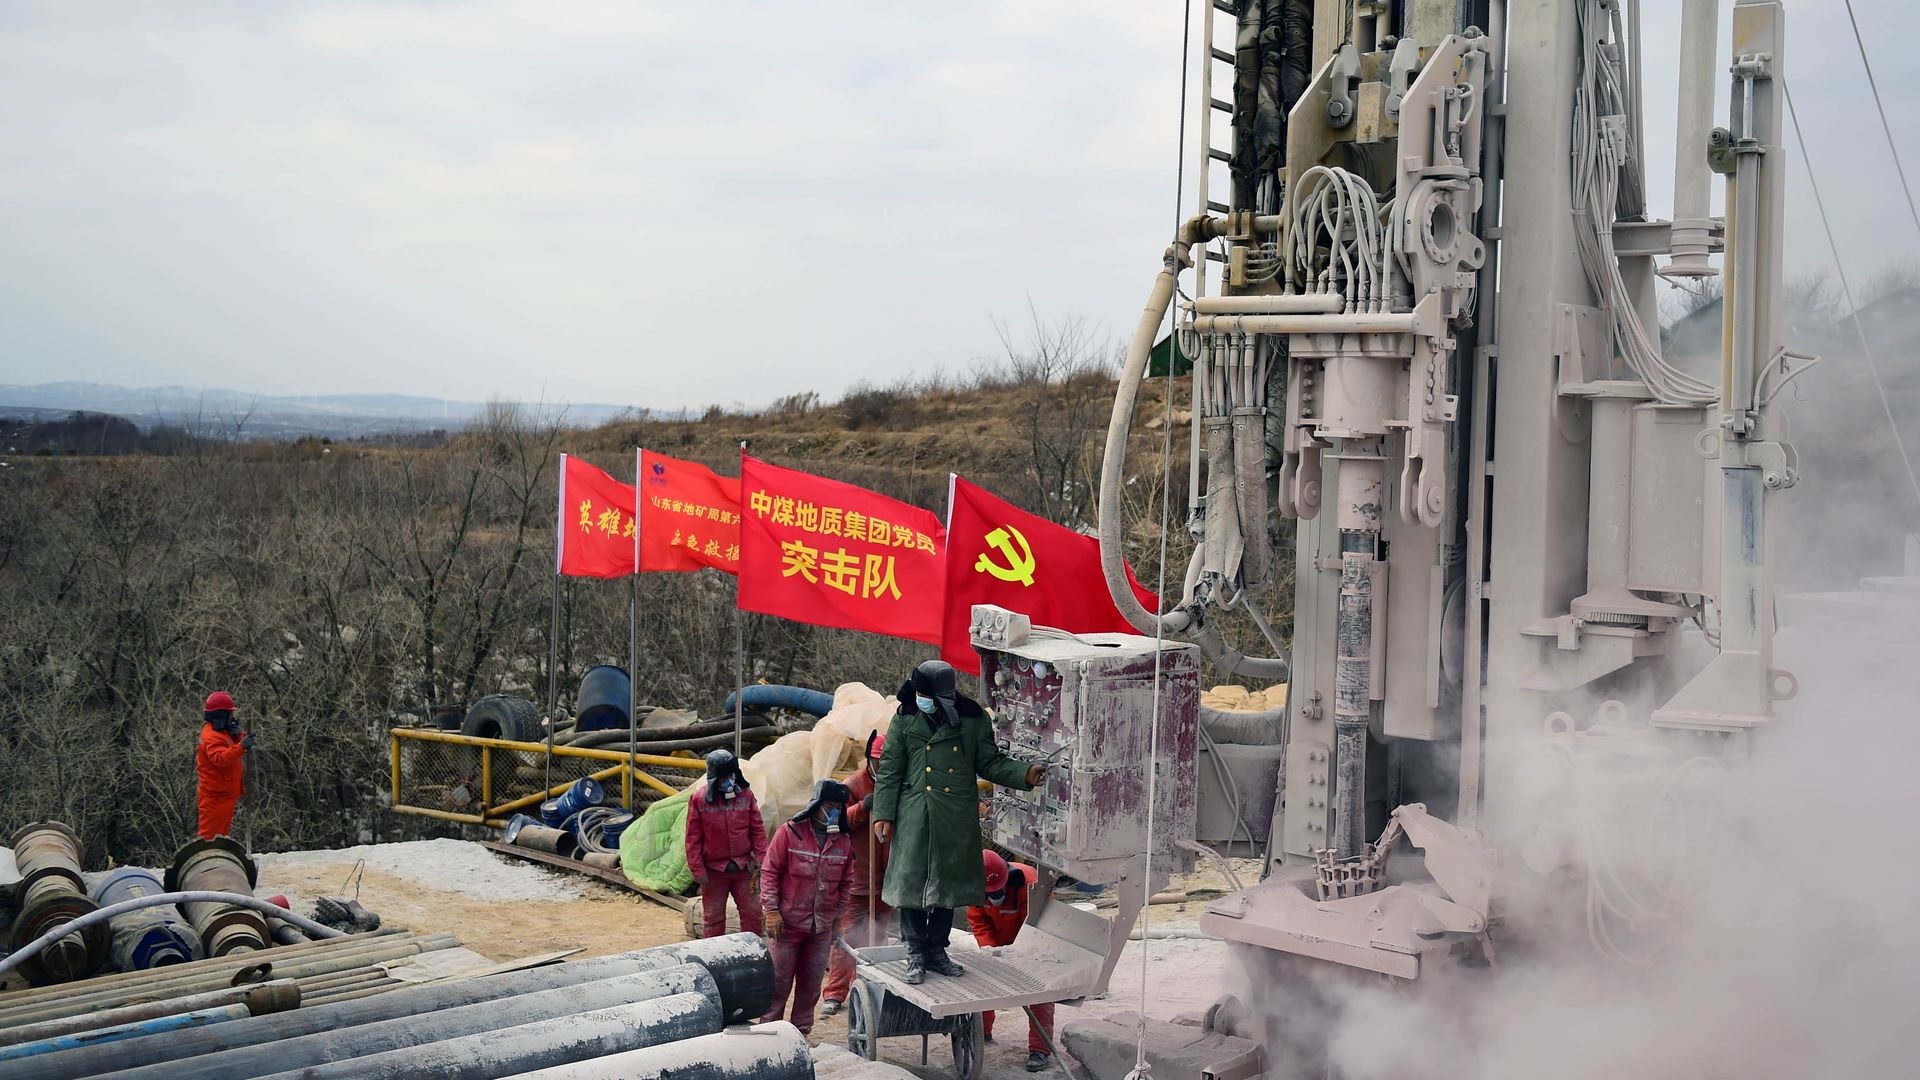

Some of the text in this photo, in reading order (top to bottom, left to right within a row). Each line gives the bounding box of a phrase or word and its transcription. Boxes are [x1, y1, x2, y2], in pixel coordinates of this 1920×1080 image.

[750, 489, 937, 556] 中煤地质集团党员
[781, 540, 903, 600] 突击队
